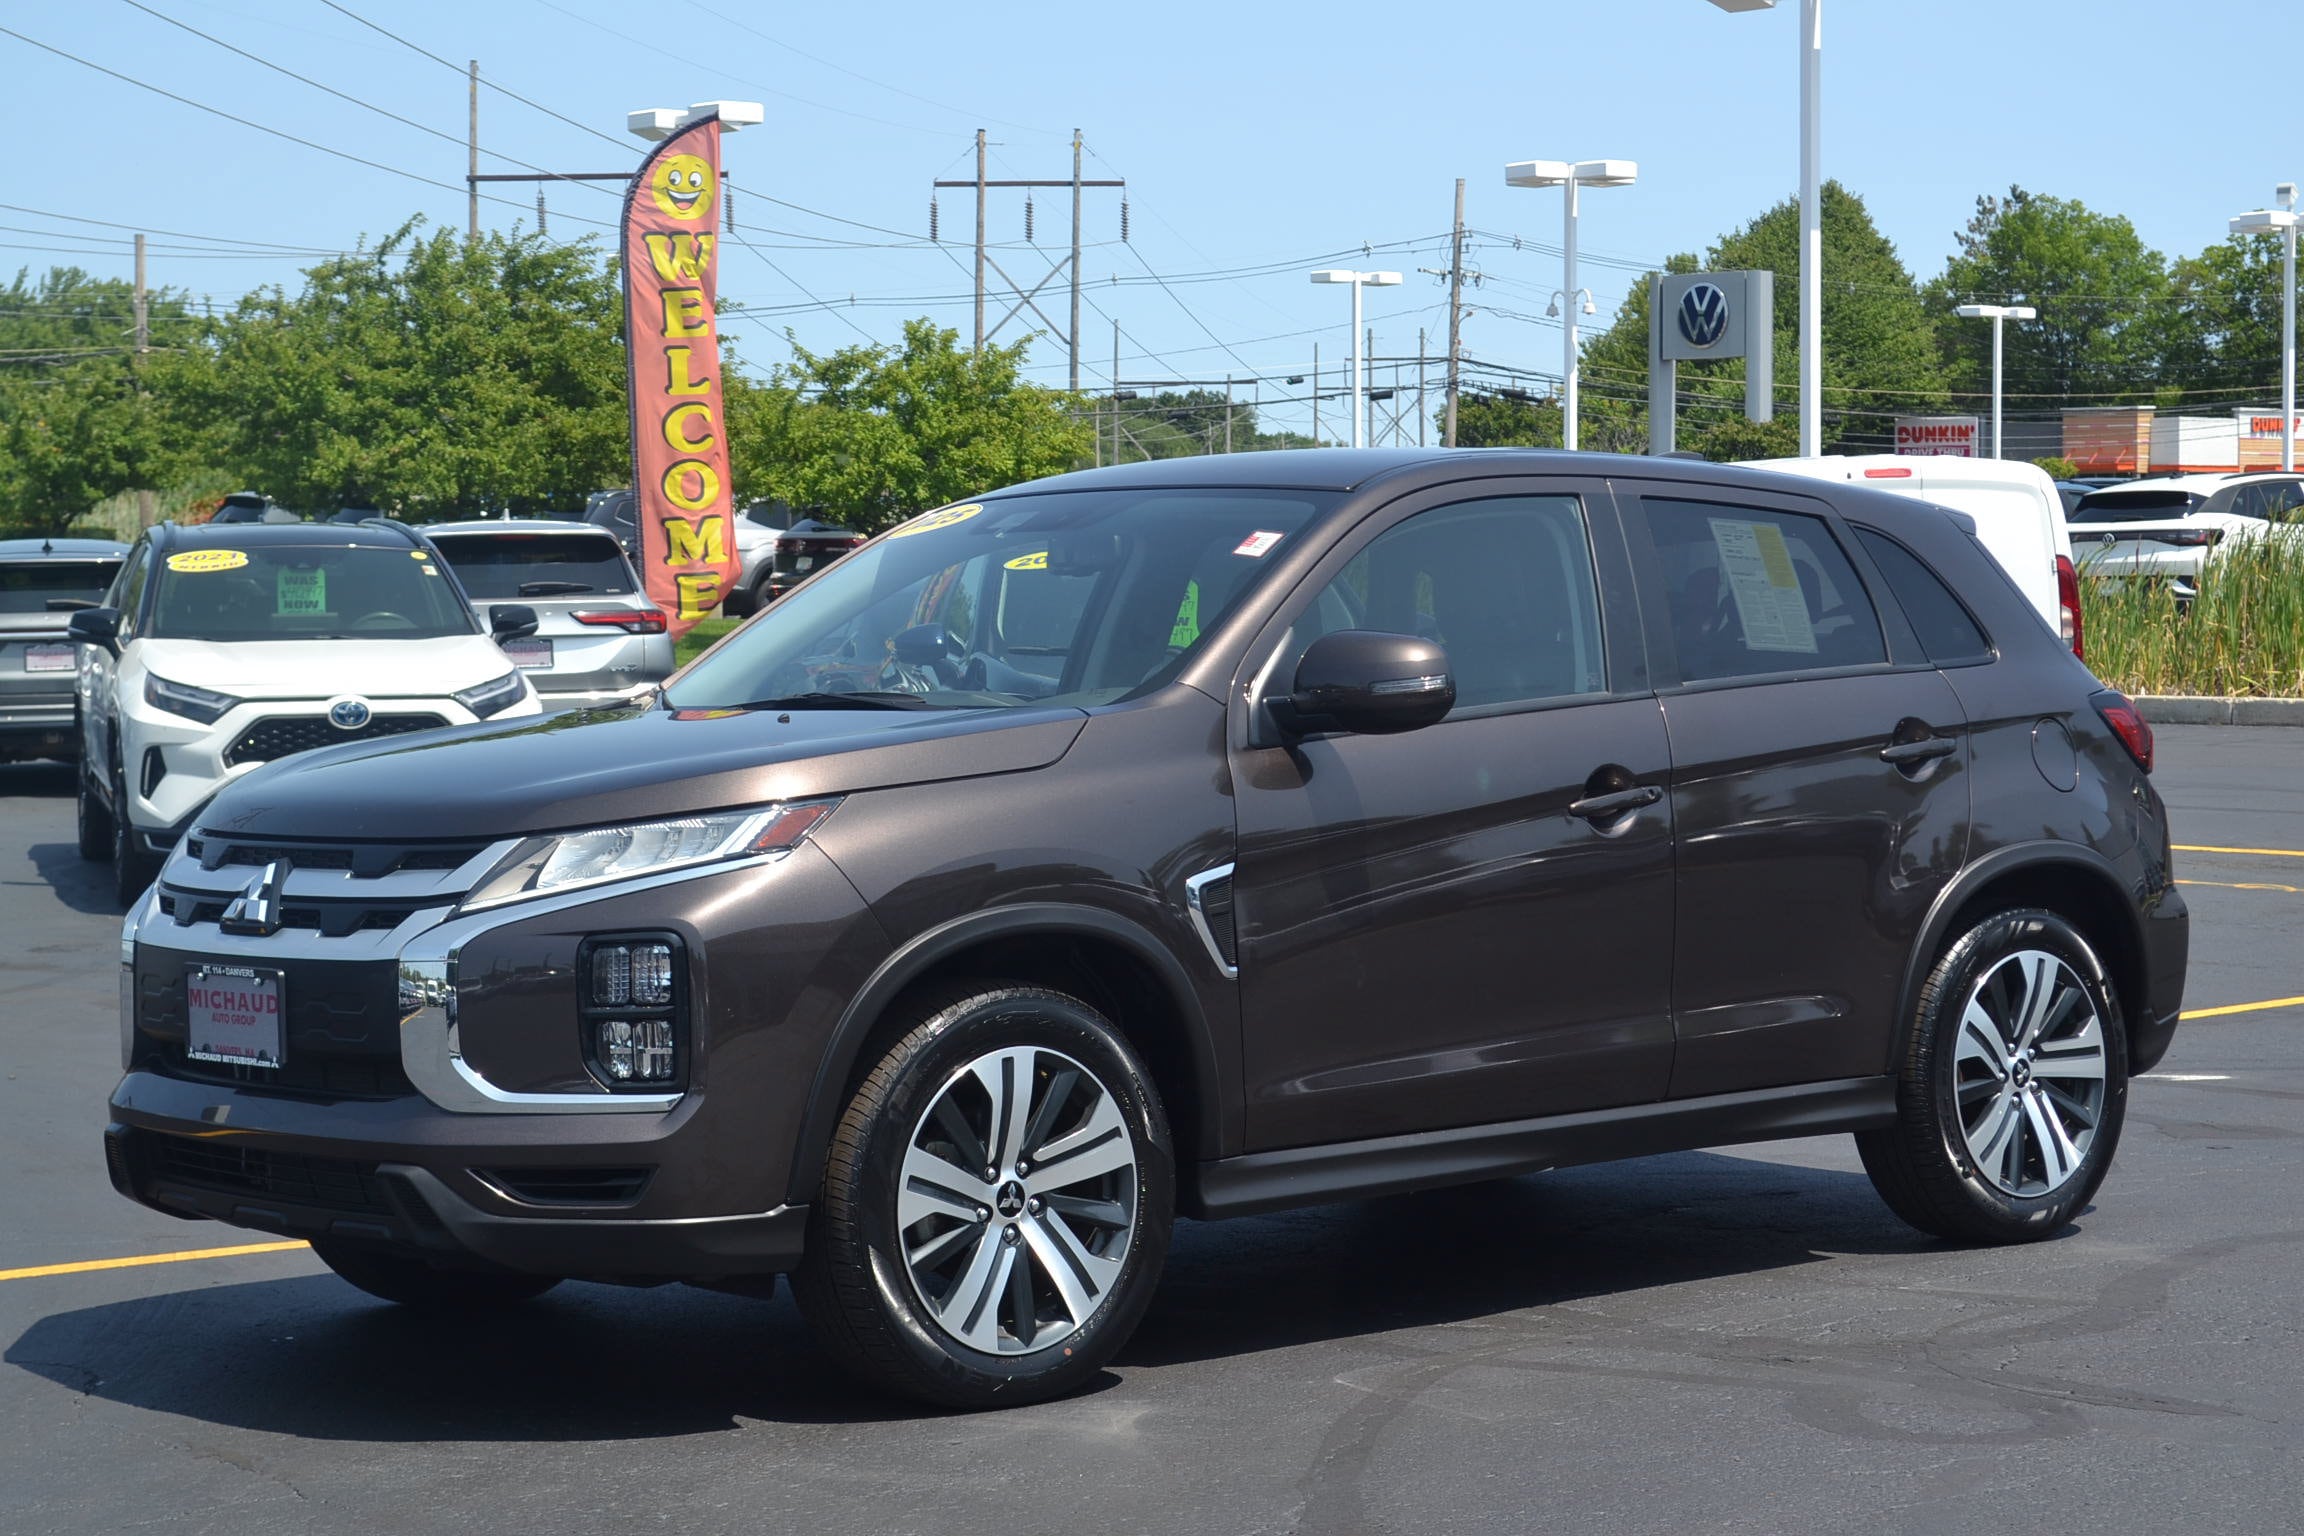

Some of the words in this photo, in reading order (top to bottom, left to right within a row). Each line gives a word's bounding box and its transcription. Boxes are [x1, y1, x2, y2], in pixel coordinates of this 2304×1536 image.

[642, 231, 728, 622] WELCOME
[1897, 424, 1975, 444] DUNKIN'
[1904, 447, 1934, 456] DRIVE
[1937, 447, 1965, 456] THRU
[1015, 555, 1047, 568] 20
[284, 576, 319, 586] WAS
[284, 600, 320, 609] NOW
[225, 967, 255, 978] DANVERS
[189, 988, 279, 1014] MICHAUD
[212, 1013, 230, 1024] AUTO
[231, 1014, 256, 1026] GROUP
[195, 1051, 221, 1062] MICHAUD
